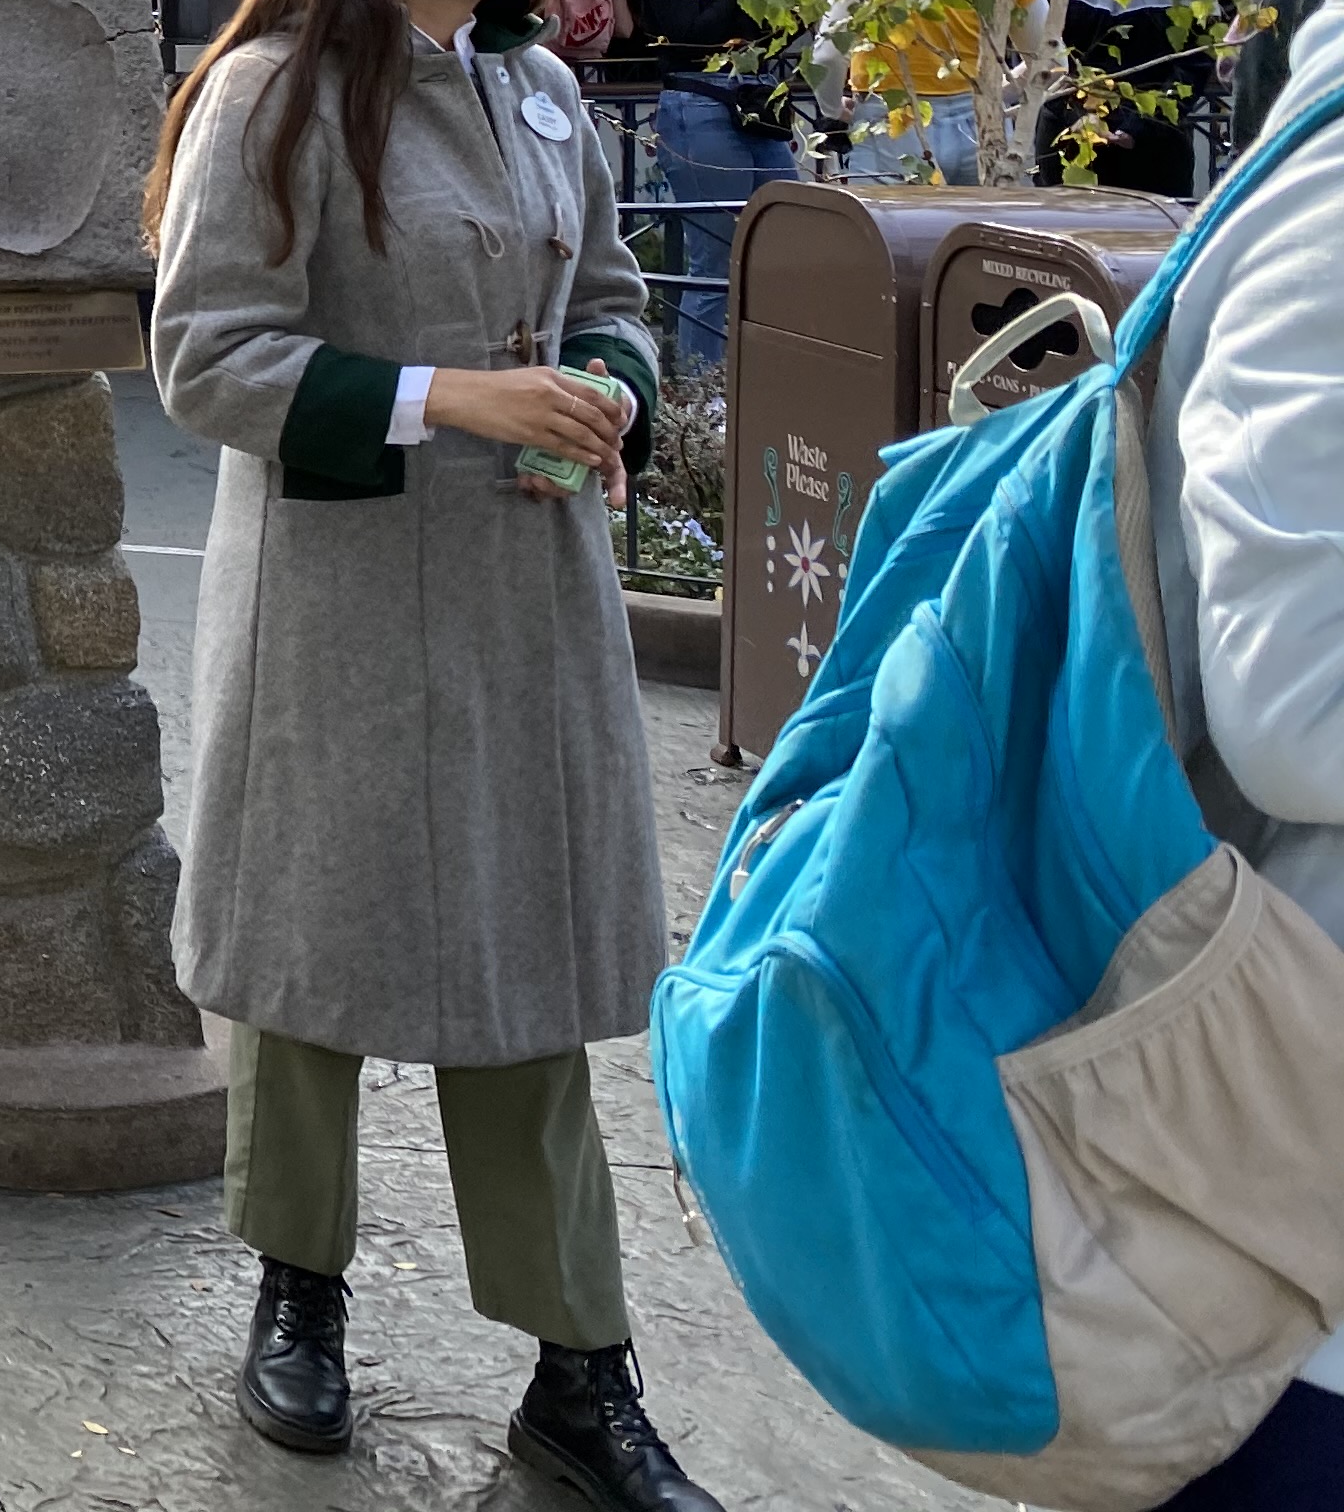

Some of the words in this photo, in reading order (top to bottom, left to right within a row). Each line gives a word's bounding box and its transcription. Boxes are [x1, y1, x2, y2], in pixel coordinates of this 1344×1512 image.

[981, 258, 1013, 277] MIXED
[1015, 266, 1072, 290] RECYCLING
[992, 374, 1020, 393] CANS
[787, 433, 828, 472] Waste
[786, 462, 829, 502] Please
